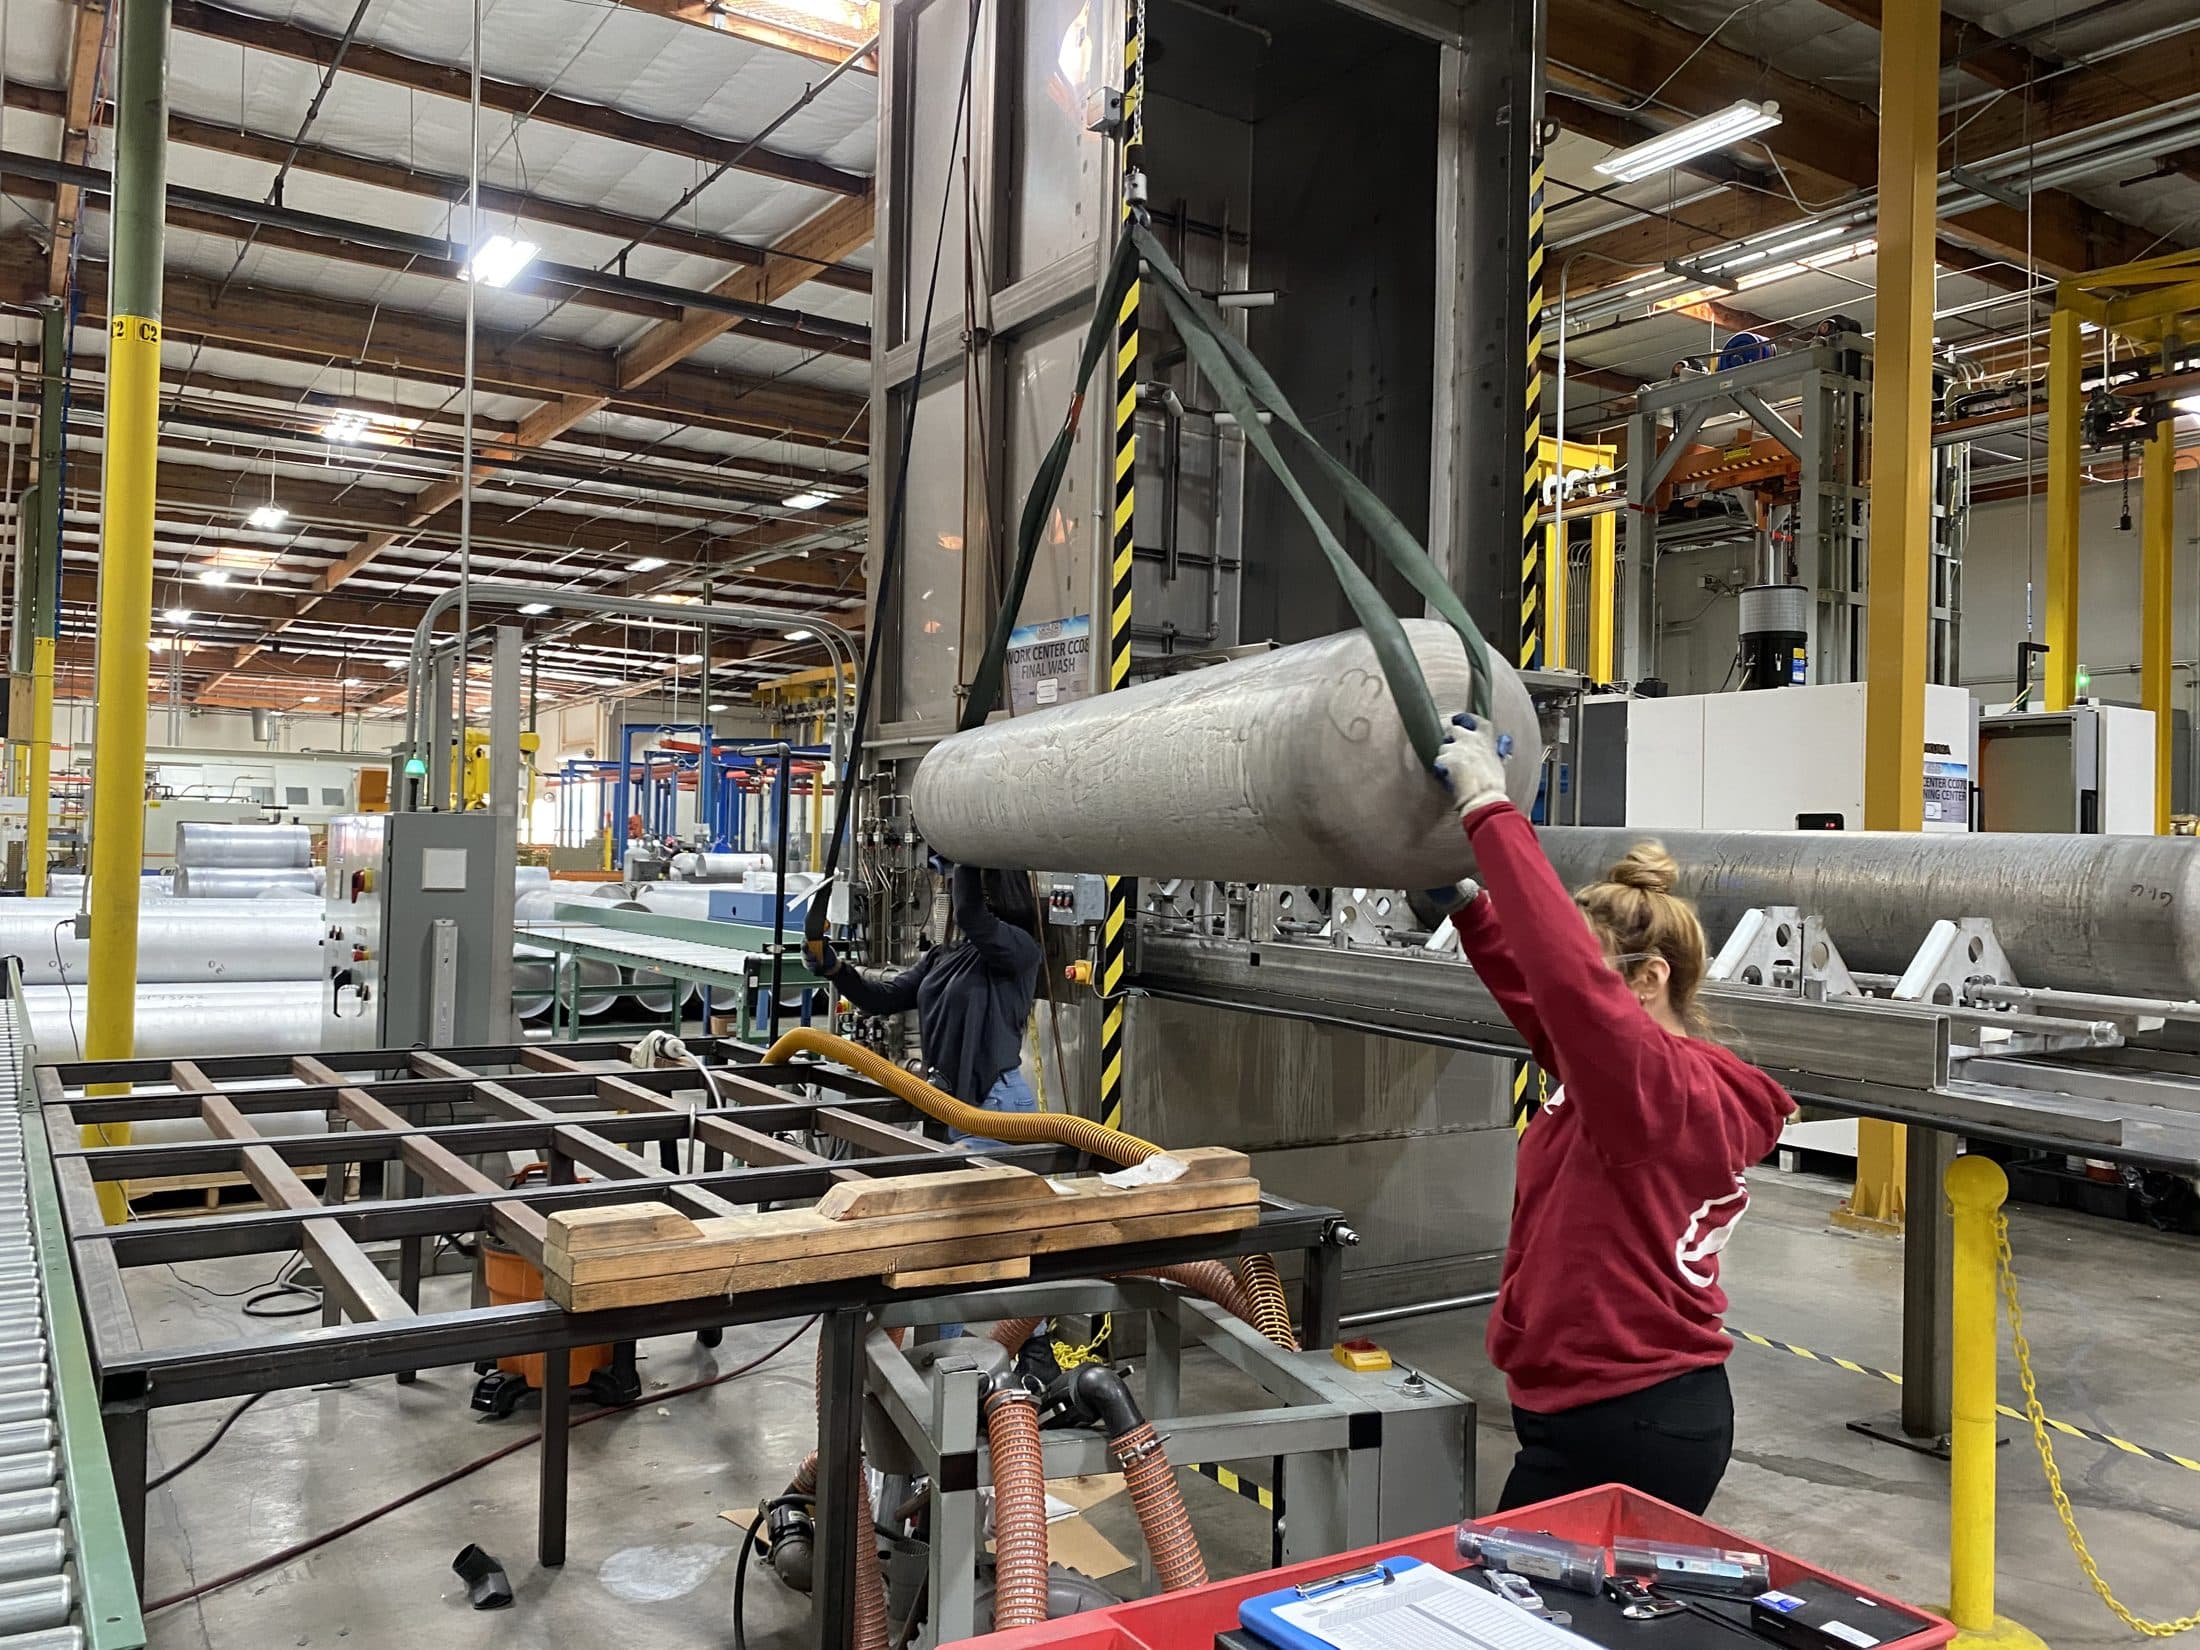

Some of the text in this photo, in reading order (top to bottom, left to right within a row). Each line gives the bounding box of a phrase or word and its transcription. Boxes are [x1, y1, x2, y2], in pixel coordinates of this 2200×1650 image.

[139, 323, 158, 342] C2
[1006, 647, 1031, 664] WORK
[1032, 643, 1066, 660] CENTER
[1021, 657, 1076, 680] FINAL WASH
[1941, 790, 1967, 801] CENTER
